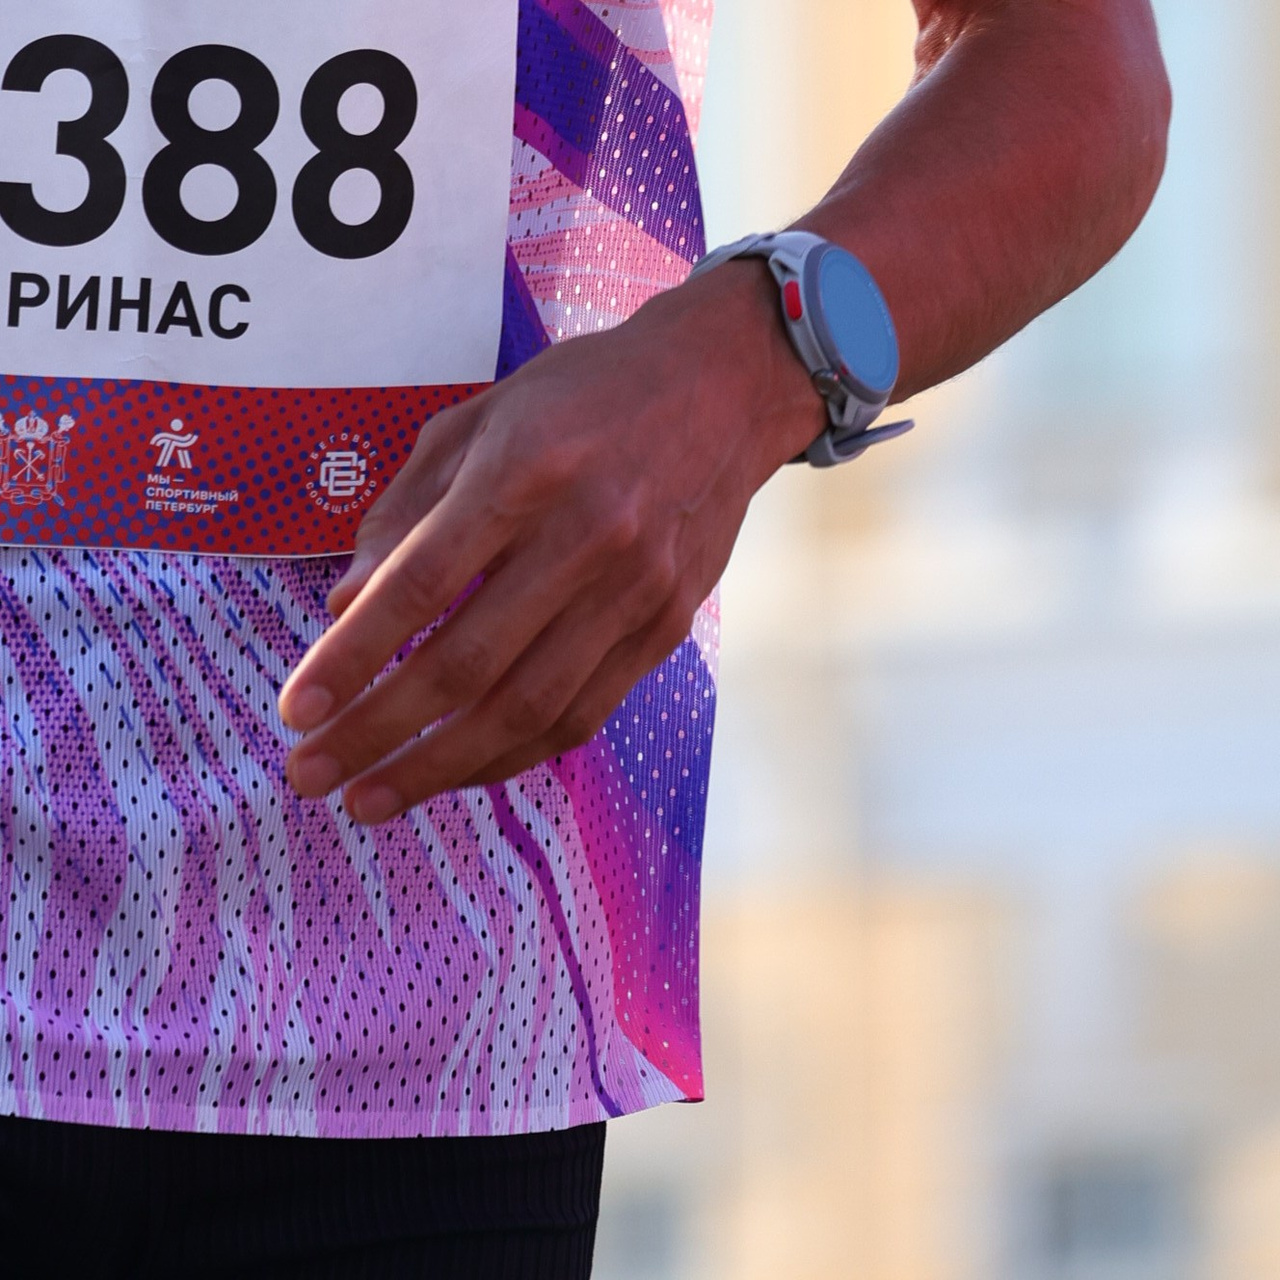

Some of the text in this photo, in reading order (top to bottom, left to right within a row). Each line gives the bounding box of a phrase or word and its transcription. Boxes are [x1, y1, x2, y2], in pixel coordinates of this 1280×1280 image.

[7, 272, 252, 340] РИНАС
[310, 432, 378, 459] БЕГОВОЕ
[147, 474, 170, 484] МЫ
[145, 487, 239, 501] СПОРТИВНЫЙ
[305, 480, 377, 515] СООБЩЕСТВО
[145, 500, 218, 514] ПЕТЕРБУРГ
